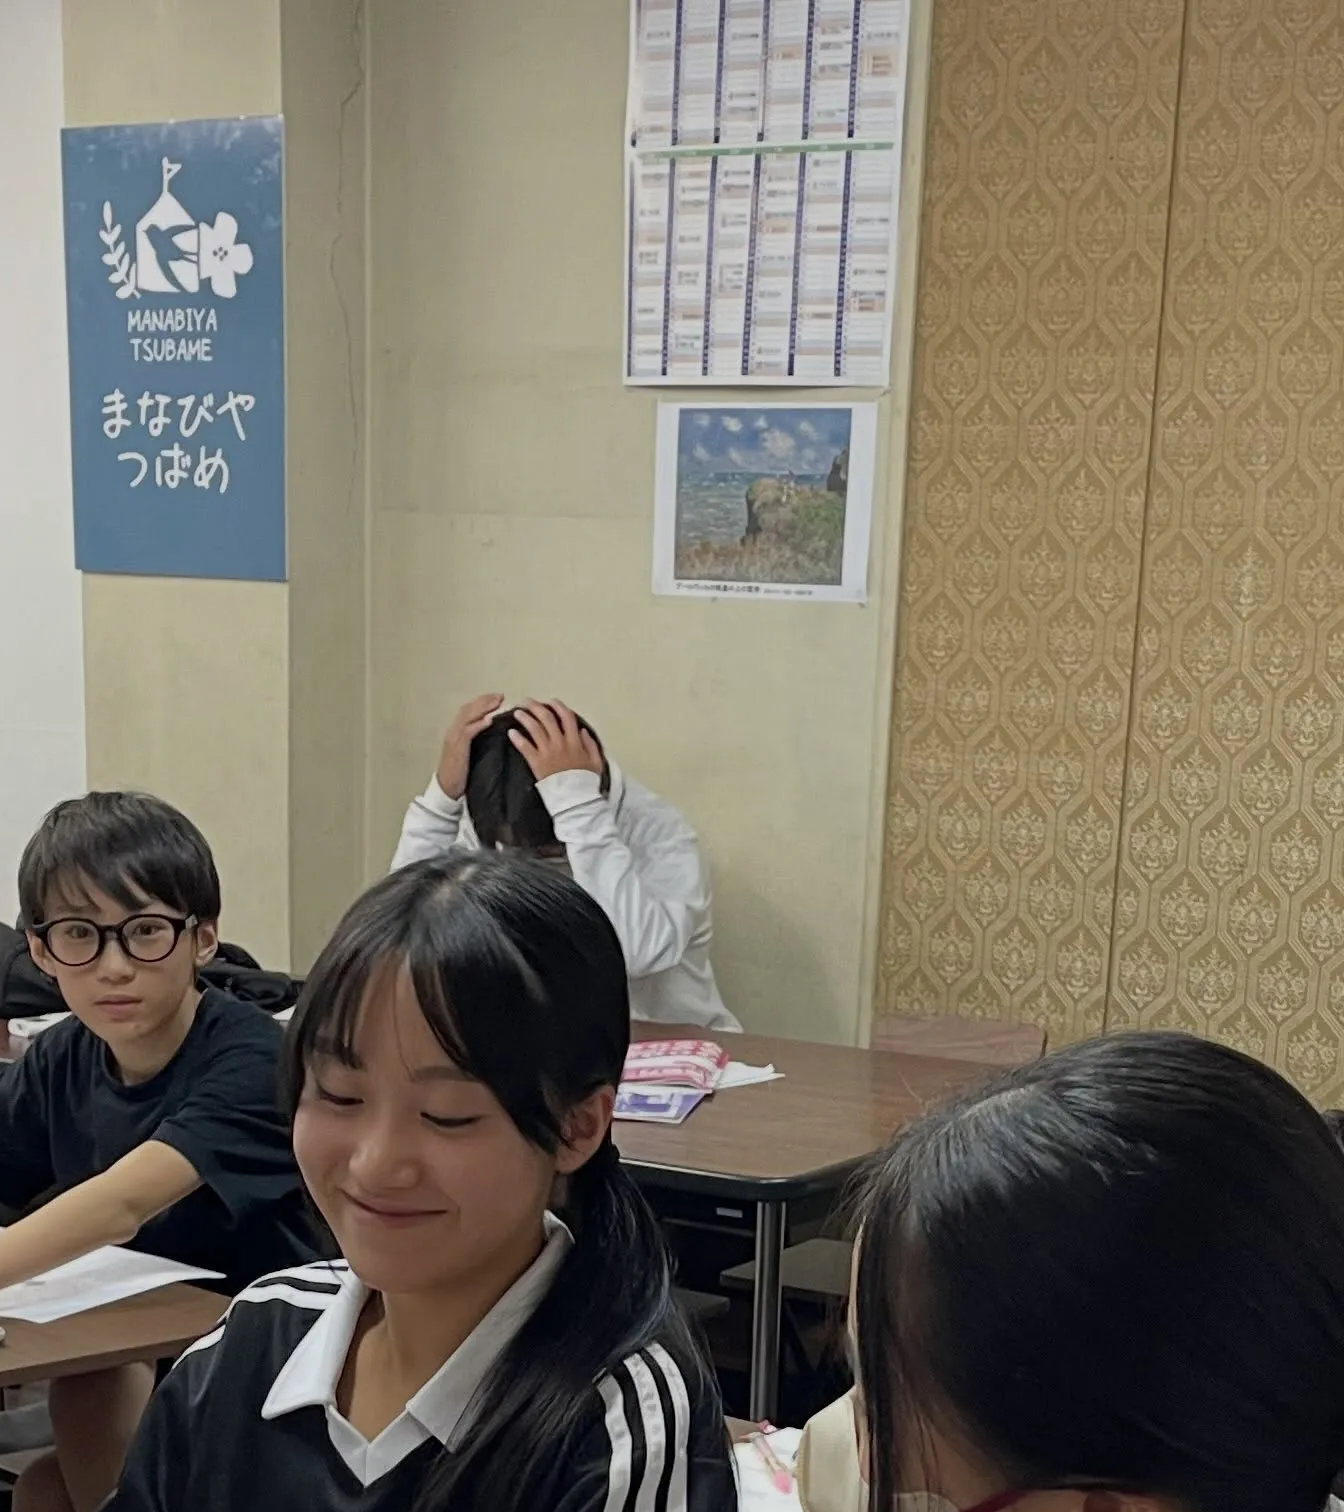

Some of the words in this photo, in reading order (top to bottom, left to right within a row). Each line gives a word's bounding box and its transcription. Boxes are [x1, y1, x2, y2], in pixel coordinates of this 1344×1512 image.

[127, 307, 218, 333] MANABIYA
[130, 338, 214, 362] TSUBAME
[100, 387, 256, 441] まなびや
[117, 442, 230, 494] つばめ
